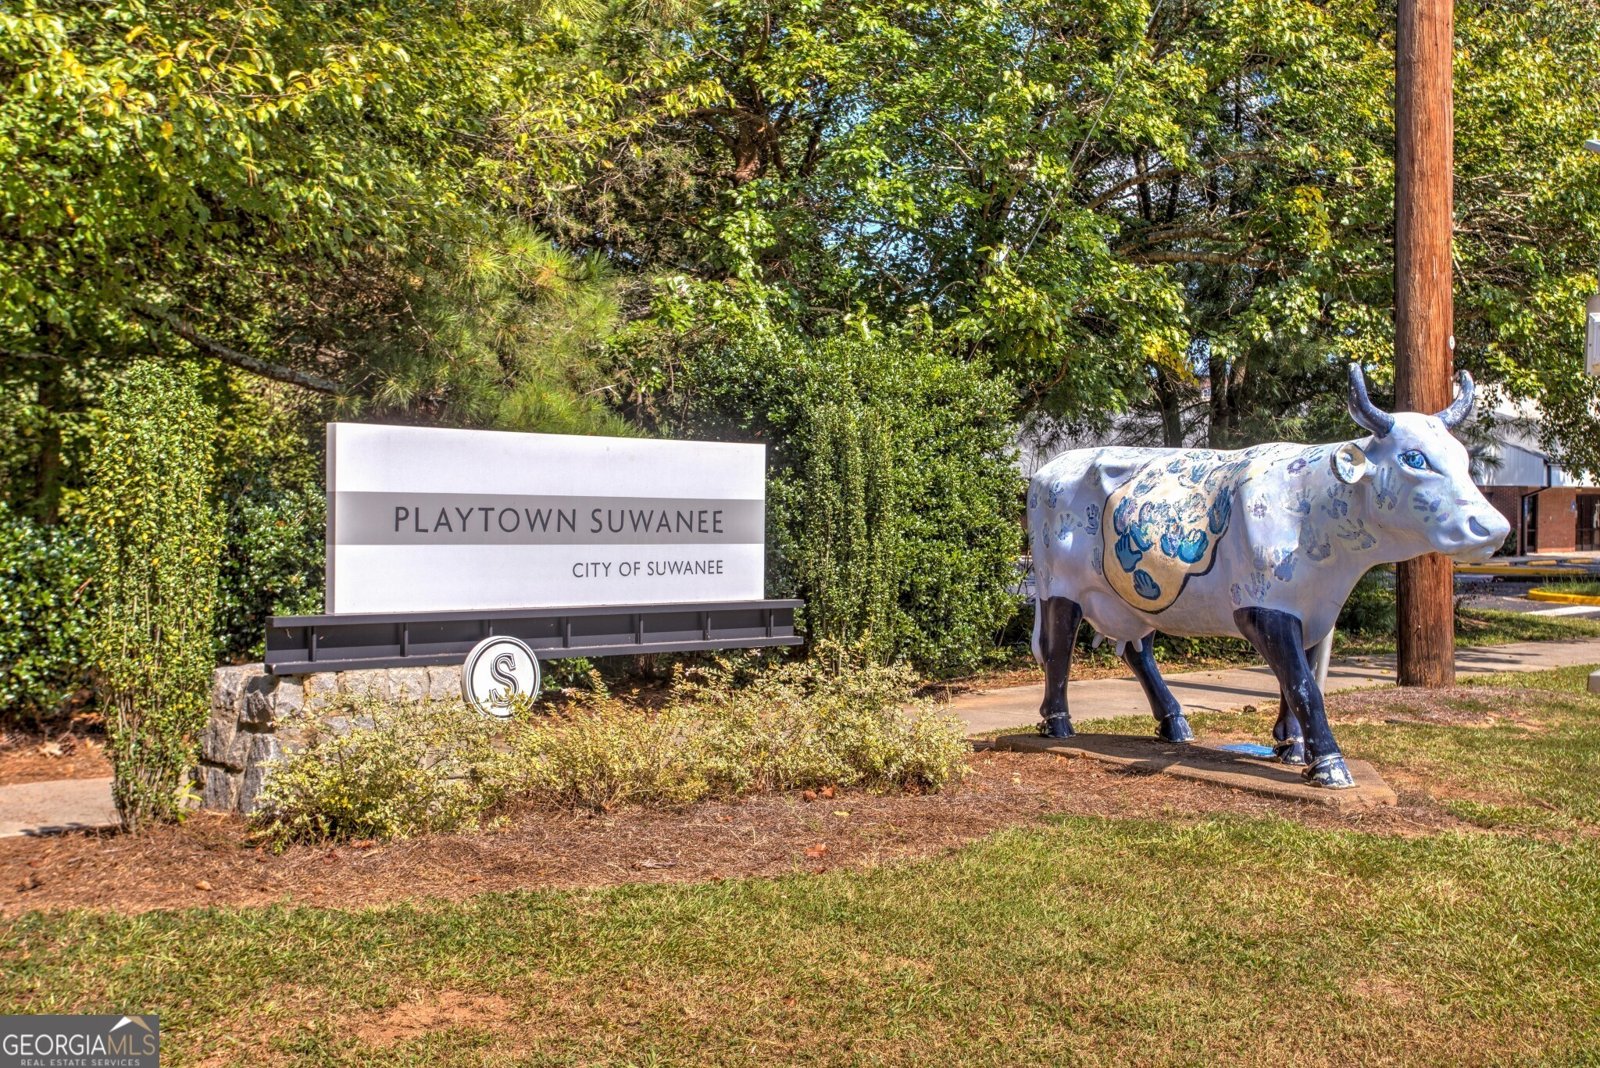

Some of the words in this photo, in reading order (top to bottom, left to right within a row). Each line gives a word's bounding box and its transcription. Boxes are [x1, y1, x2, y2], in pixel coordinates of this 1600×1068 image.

[395, 506, 577, 533] PLAYTOWN
[590, 508, 724, 534] SUWANEE
[572, 561, 612, 579] CITY
[618, 561, 641, 577] OF
[647, 559, 724, 577] SUWANEE
[490, 652, 520, 707] S
